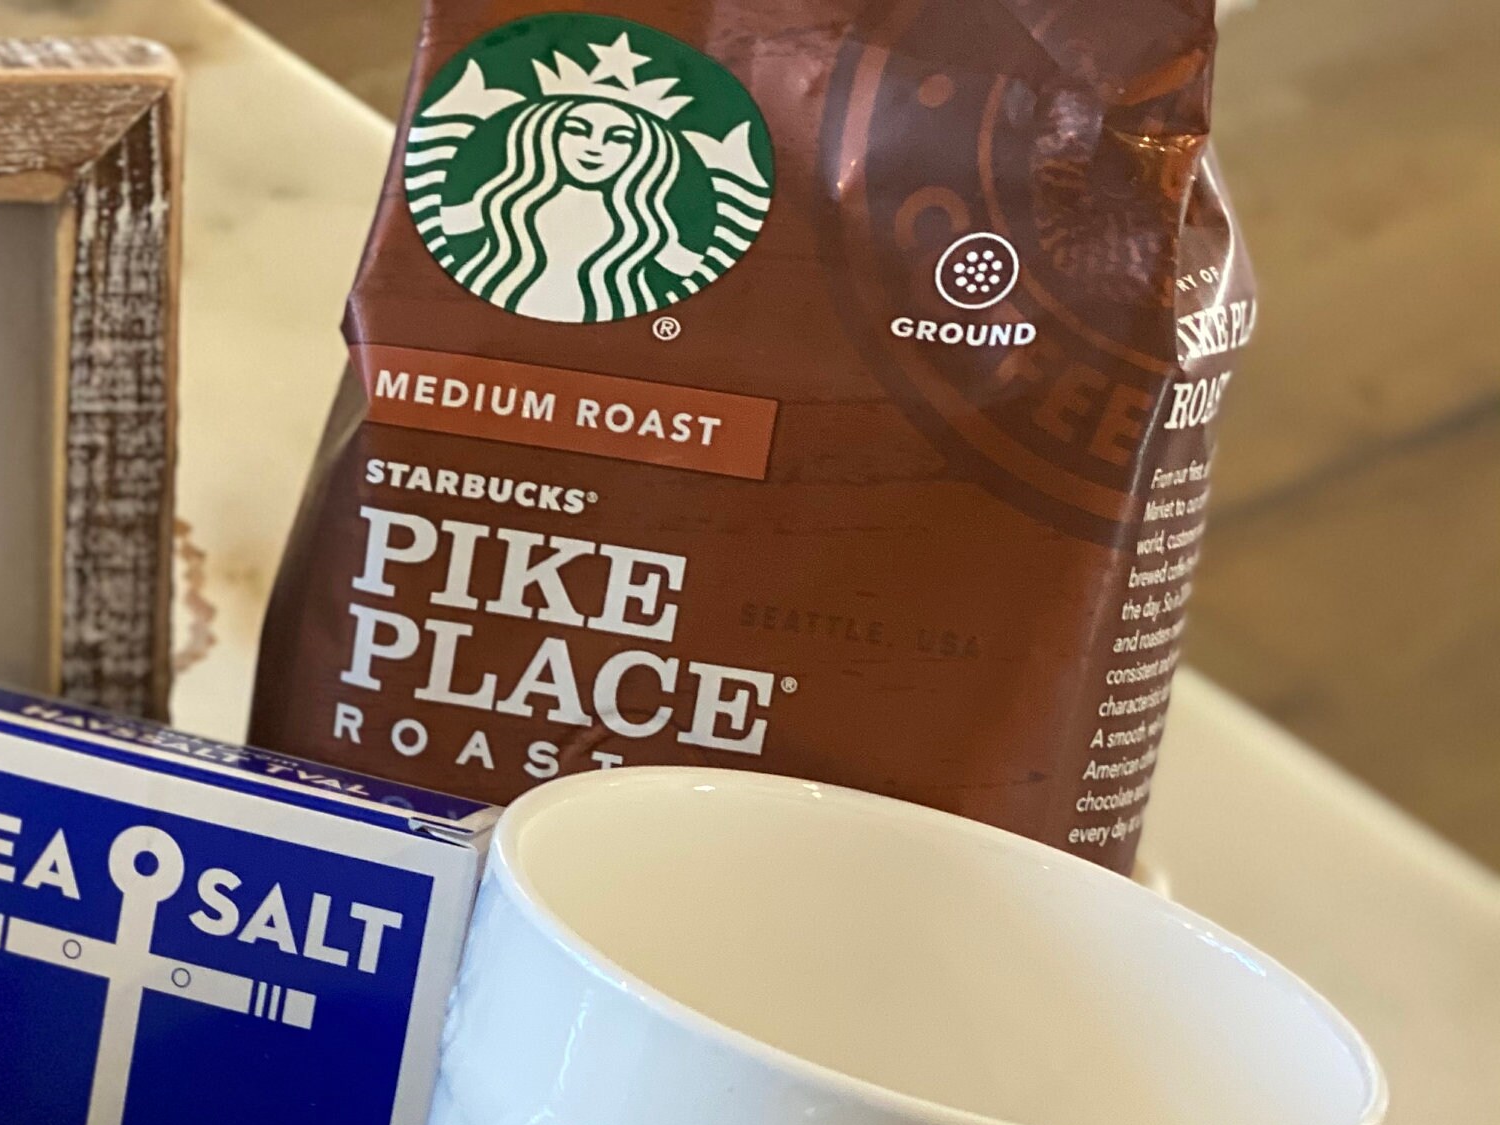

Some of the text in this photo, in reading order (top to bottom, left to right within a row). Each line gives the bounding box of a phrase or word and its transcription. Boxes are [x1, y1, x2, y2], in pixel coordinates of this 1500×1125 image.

[1176, 273, 1198, 292] RY
[891, 317, 1037, 347] GROUND
[375, 369, 721, 446] MEDIUM ROAST
[351, 506, 687, 643] PIKE
[1113, 630, 1139, 653] and
[264, 762, 370, 796] TVAL
[1069, 826, 1110, 847] every
[188, 868, 403, 974] SALT
